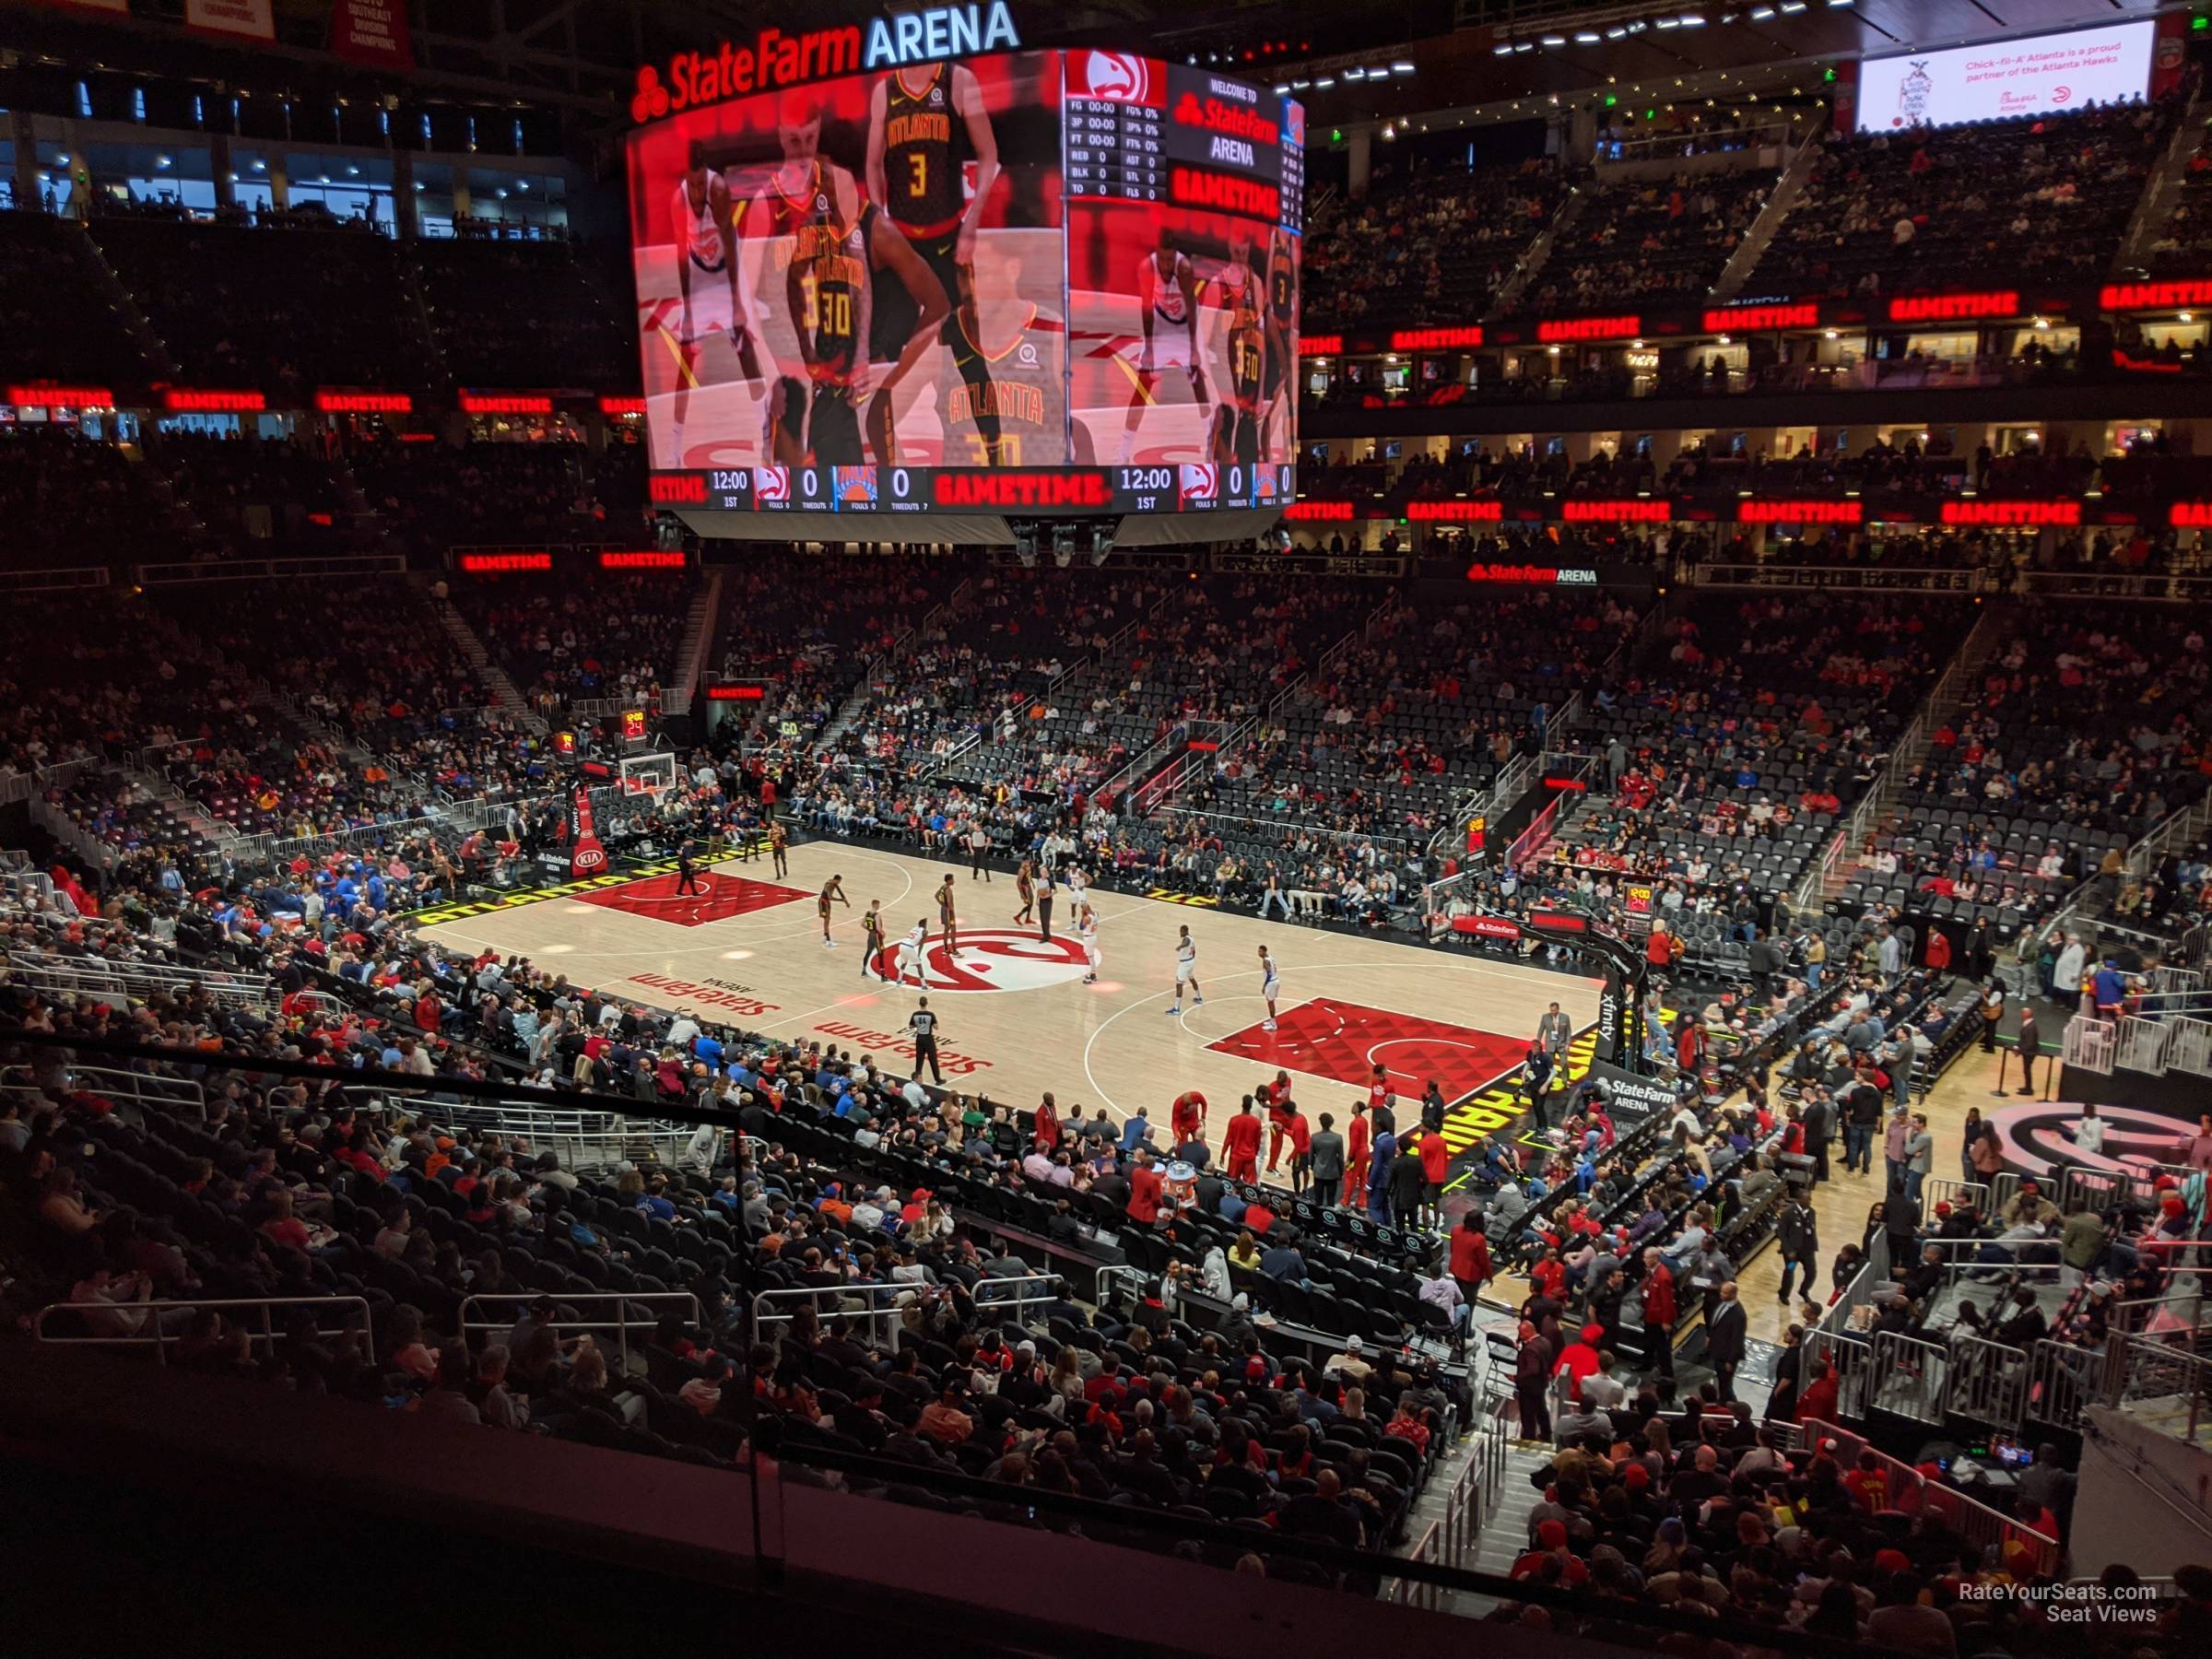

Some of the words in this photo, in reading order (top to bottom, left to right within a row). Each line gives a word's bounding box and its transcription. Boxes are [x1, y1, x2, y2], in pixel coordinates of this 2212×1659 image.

[350, 31, 395, 51] CHAMPIONS
[865, 1, 1020, 68] ARENA
[2027, 51, 2065, 63] Atlanta
[2088, 41, 2121, 55] proud
[1966, 69, 2005, 82] partner
[2007, 67, 2018, 76] of
[2022, 65, 2039, 74] the
[2041, 62, 2079, 72] Atlanta
[2083, 55, 2118, 65] Hawks
[1211, 78, 1246, 101] WELCOME
[1246, 89, 1256, 103] TO
[1071, 101, 1082, 111] FG
[1146, 108, 1158, 119] 0%
[888, 112, 950, 148] ATLANTA
[1071, 117, 1083, 127] 3P
[1146, 124, 1159, 136] 0%
[1072, 135, 1082, 144] FT
[1146, 140, 1159, 152] 0%
[1072, 151, 1088, 161] REB
[1126, 155, 1139, 165] AST
[1211, 137, 1253, 167] ARENA
[909, 154, 926, 197] 3
[1072, 168, 1088, 177] BLK
[1126, 171, 1139, 182] STL
[1073, 184, 1083, 194] TO
[822, 292, 851, 336] 30
[1890, 292, 2018, 320] GAMETIME
[1704, 304, 1818, 332] GAMETIME
[1538, 316, 1641, 342] GAMETIME
[1393, 327, 1483, 350] GAMETIME
[11, 387, 112, 406] GAMETIME
[169, 393, 265, 409] GAMETIME
[320, 395, 411, 412] GAMETIME
[465, 396, 552, 413] GAMETIME
[949, 381, 1045, 426] ATLANTA
[713, 471, 747, 489] 12:00
[803, 469, 818, 497] 0
[892, 468, 910, 497] 0
[1121, 468, 1171, 490] 12:00
[1230, 465, 1241, 494] 0
[1282, 465, 1289, 492] 0
[724, 496, 737, 507] 1ST
[769, 501, 783, 510] FOULS
[803, 501, 827, 510] TIMEOUTS
[892, 502, 919, 511] TIMEOUTS
[1137, 496, 1156, 509] 1ST
[1195, 500, 1210, 509] FOULS
[1407, 502, 1501, 520] GAMETIME
[1563, 501, 1670, 521] GAMETIME
[1739, 502, 1862, 522] GAMETIME
[1940, 502, 2080, 524] GAMETIME
[465, 555, 551, 570] GAMETIME
[602, 552, 685, 568] GAMETIME
[1557, 569, 1597, 582] ARENA
[628, 722, 643, 735] 24
[580, 853, 599, 865] KIA
[417, 872, 630, 924] ATLANTA
[1631, 898, 1646, 910] 24
[702, 976, 757, 994] ARENA
[1599, 994, 1617, 1041] xfinity
[1615, 1097, 1649, 1112] ARENA
